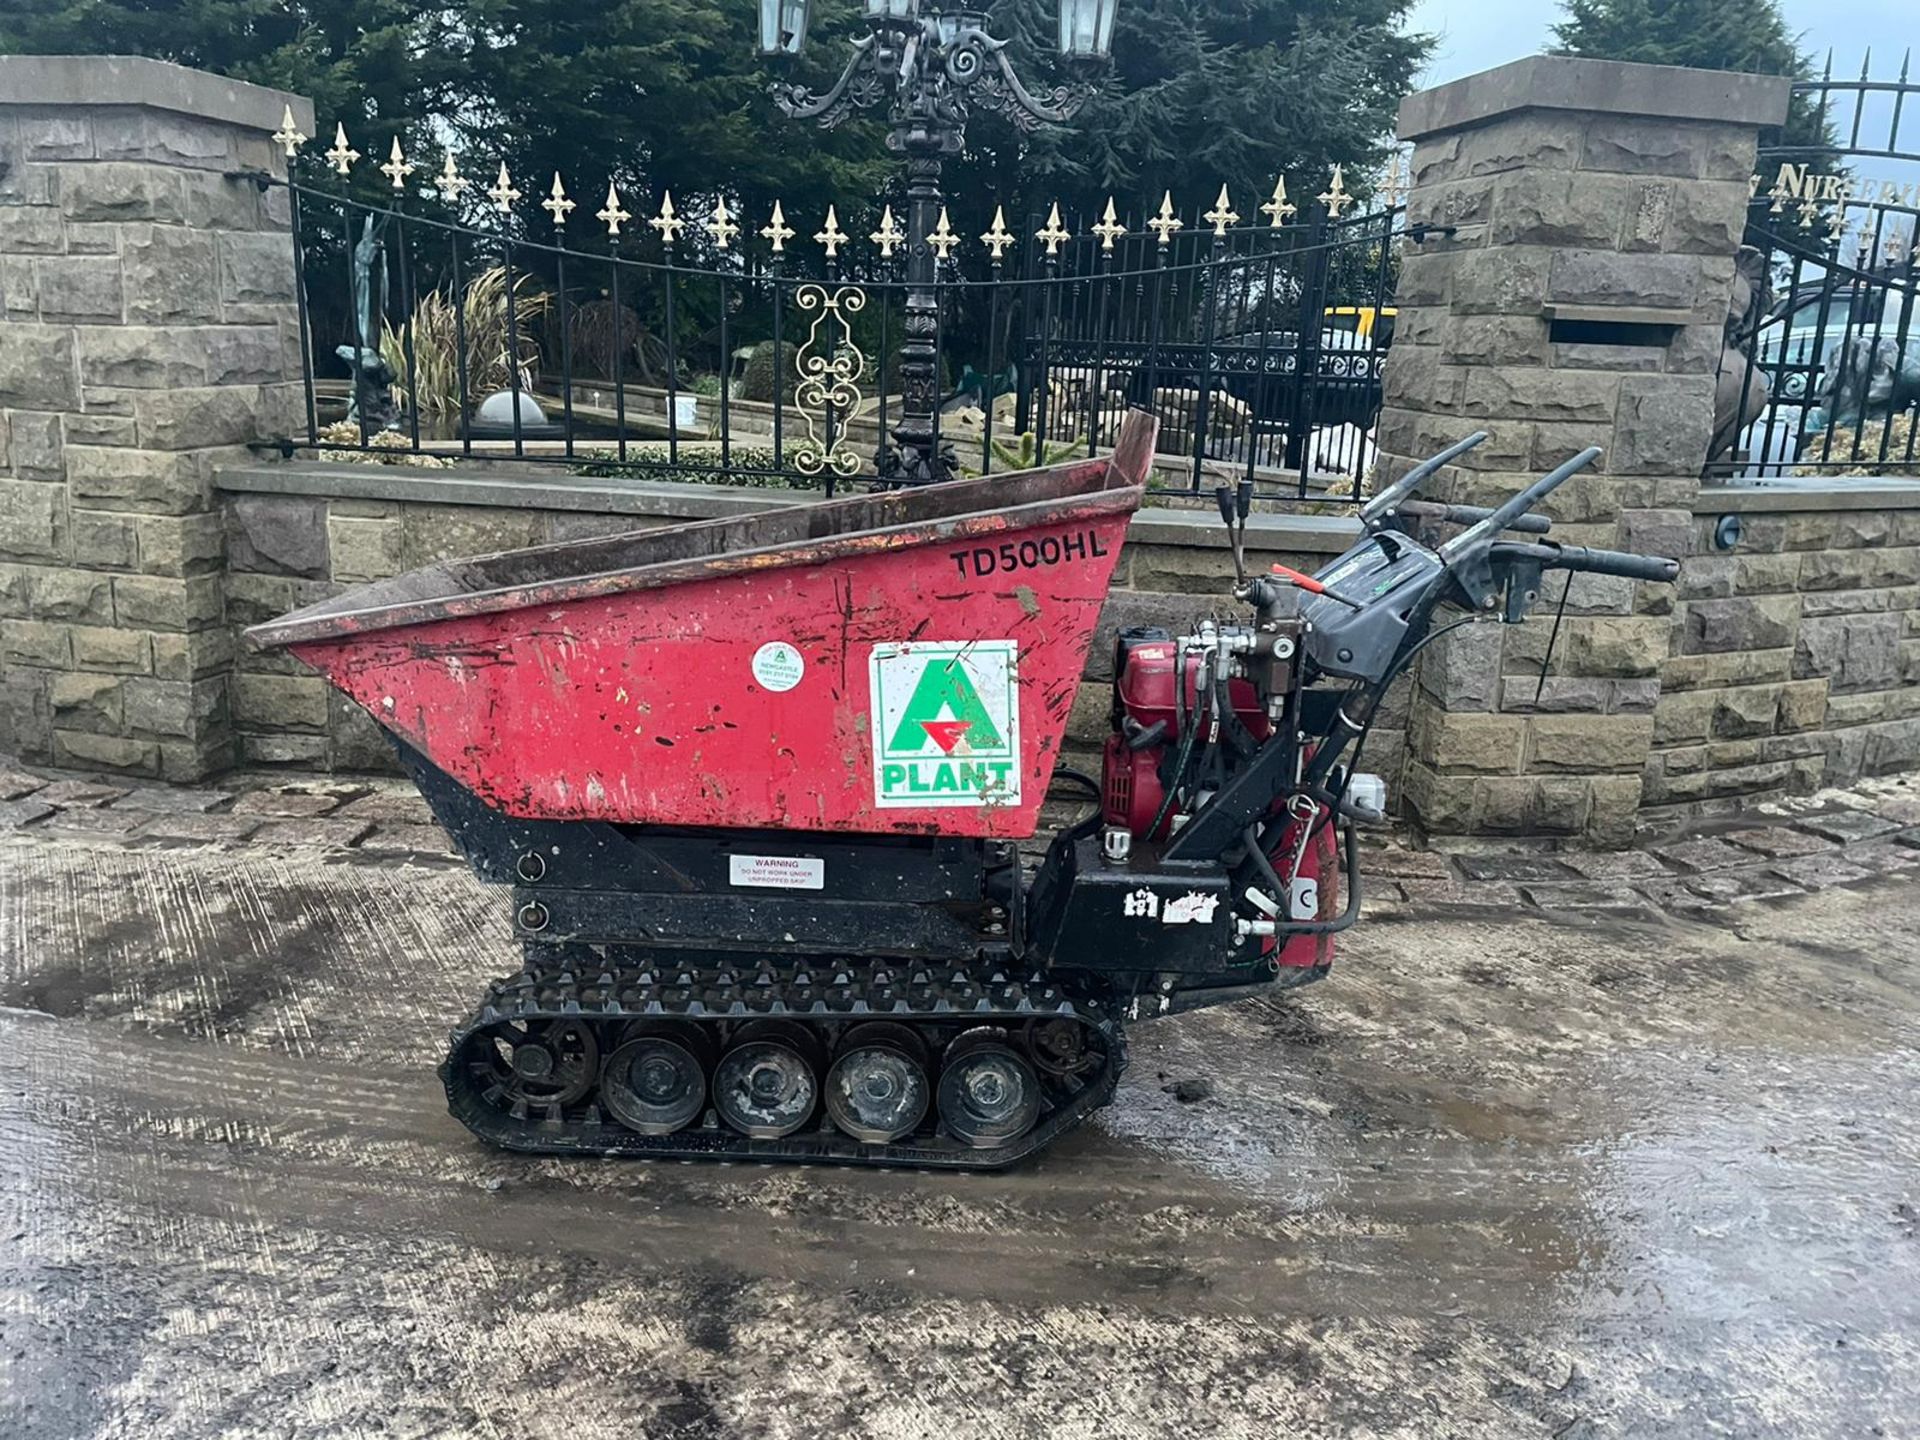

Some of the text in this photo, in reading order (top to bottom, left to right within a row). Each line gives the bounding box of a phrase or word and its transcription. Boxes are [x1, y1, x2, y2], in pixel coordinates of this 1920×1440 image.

[950, 530, 1108, 580] TD500HL
[761, 662, 798, 672] NEWCASTLE
[882, 761, 1013, 793] PLANT
[755, 859, 799, 869] WARNING
[753, 868, 766, 876] NOT
[789, 870, 813, 878] UNDER
[748, 876, 789, 884] UNPROPPED
